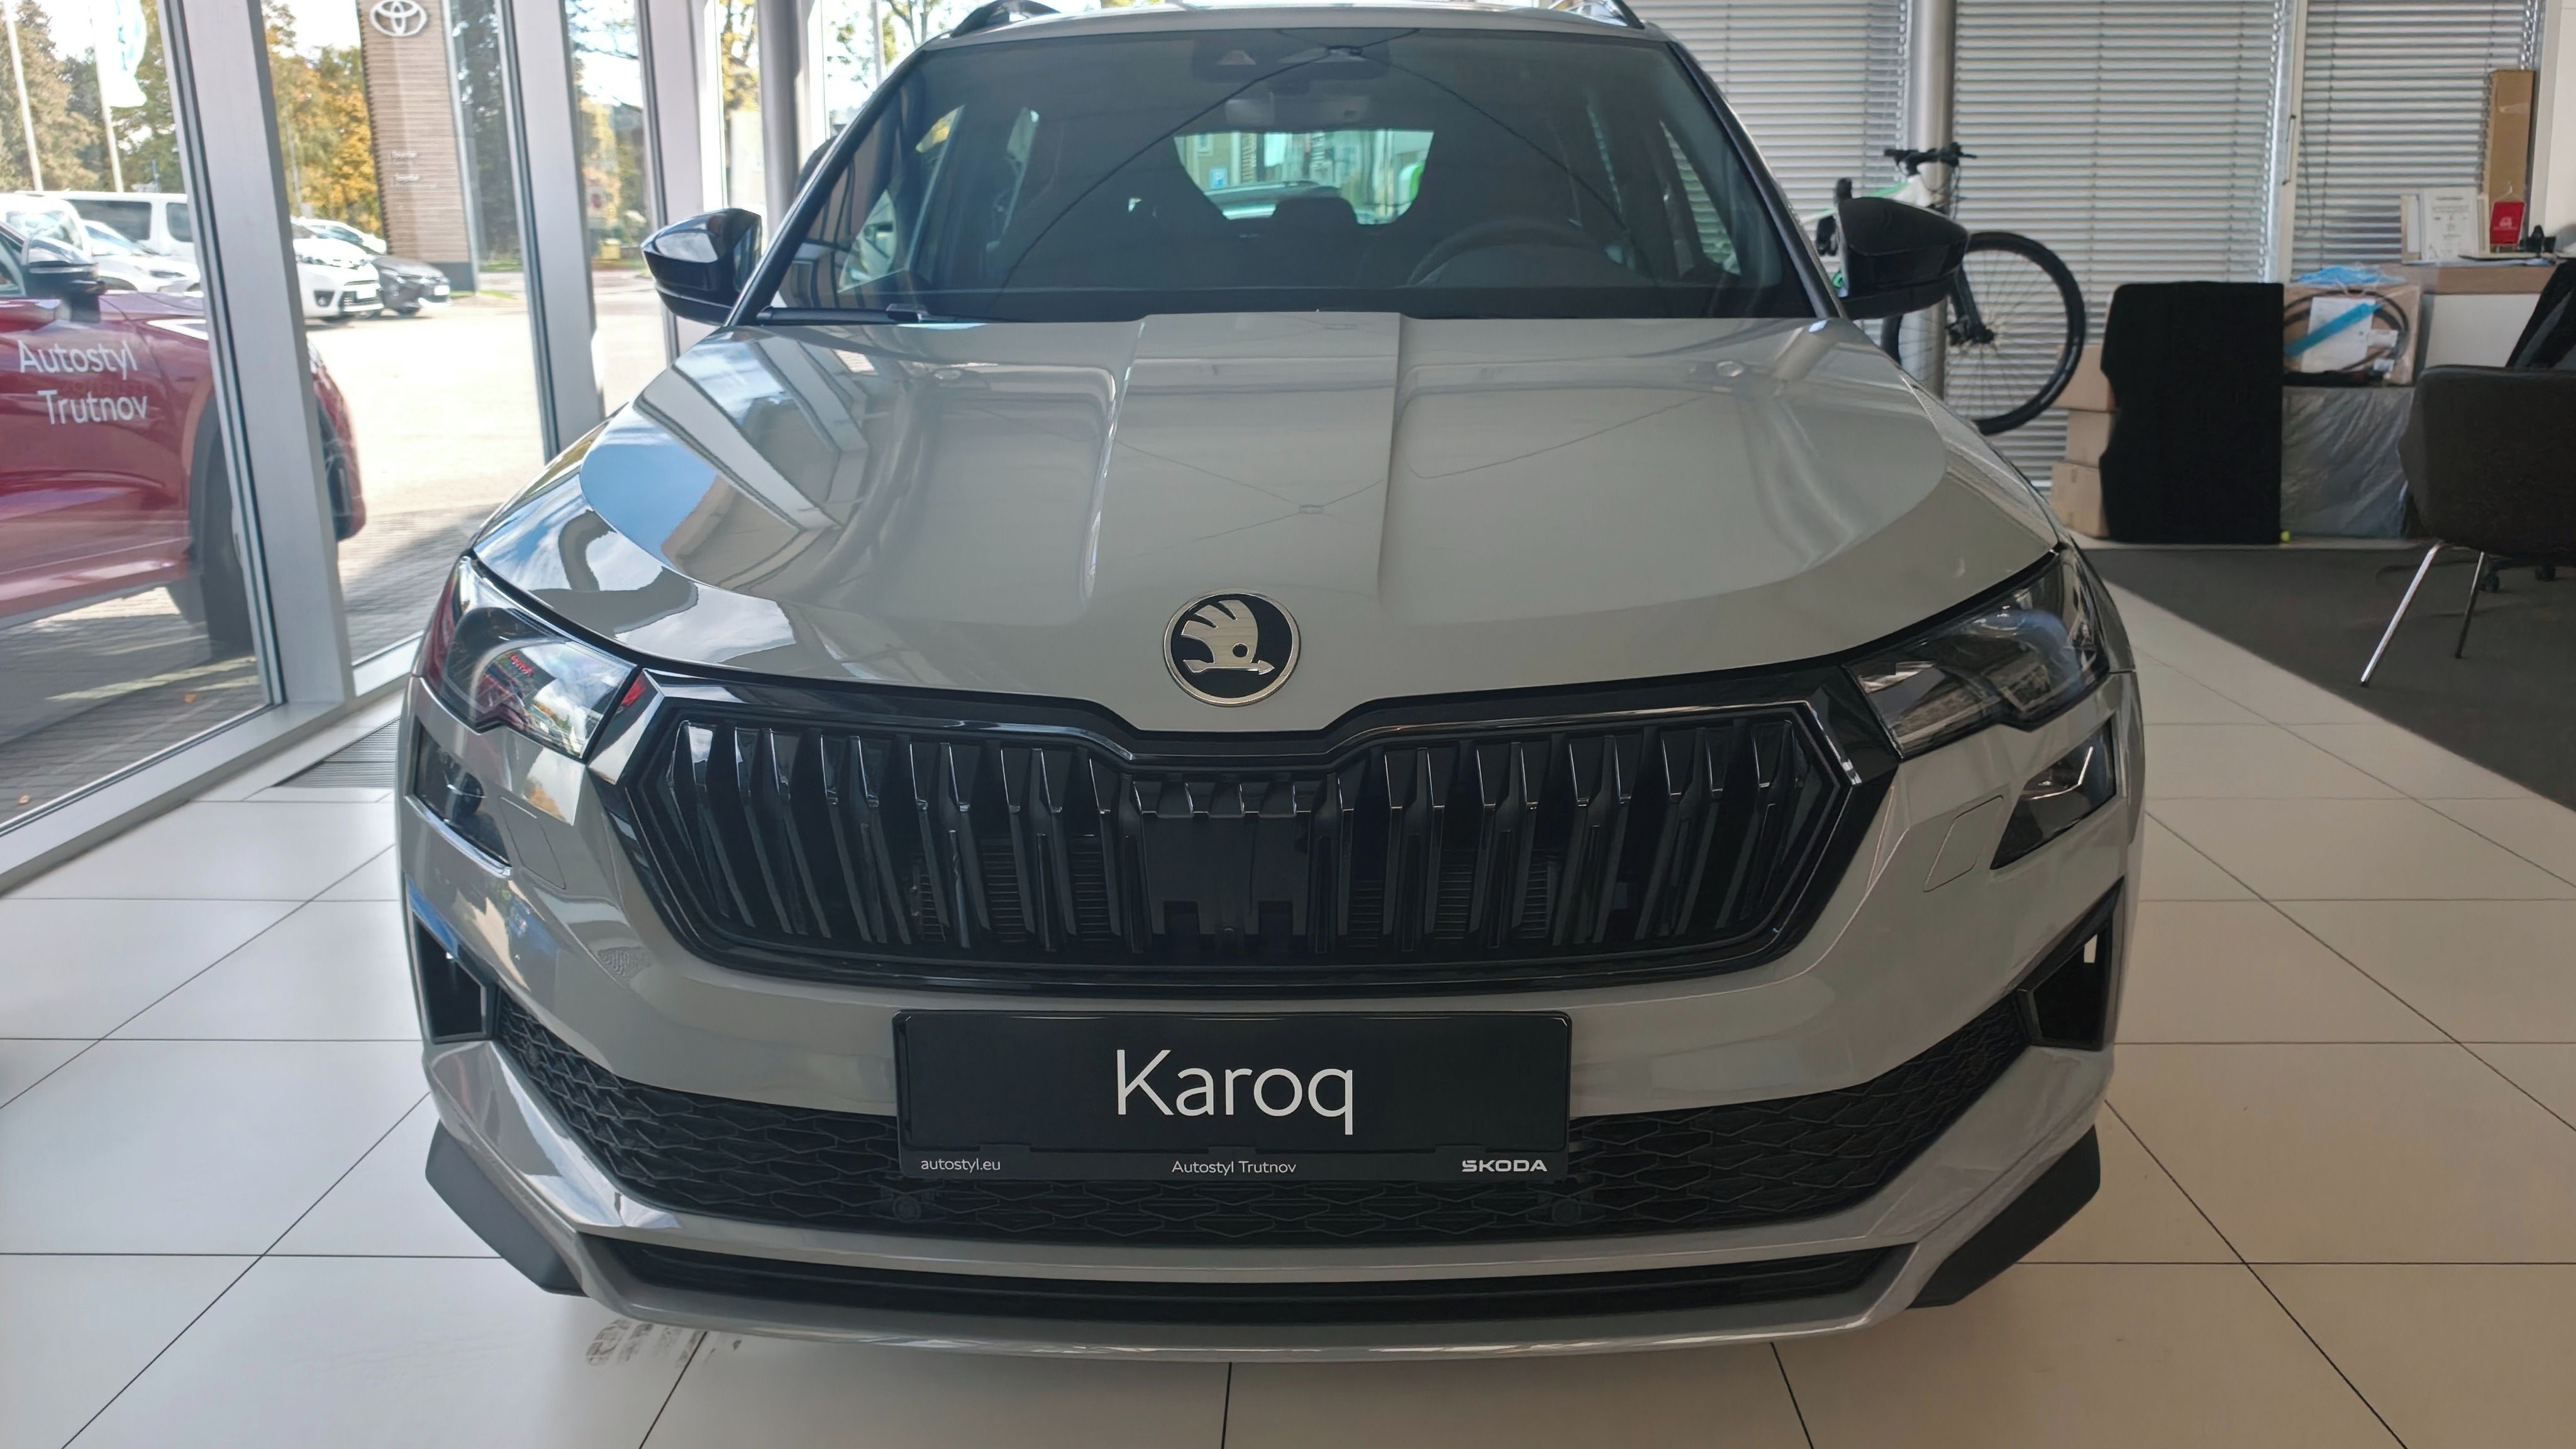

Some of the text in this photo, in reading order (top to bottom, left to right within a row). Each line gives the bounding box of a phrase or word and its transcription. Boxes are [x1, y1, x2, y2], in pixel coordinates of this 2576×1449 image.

[18, 340, 138, 380] Autostyl
[37, 389, 147, 425] Trutnov
[1116, 1049, 1353, 1135] Karoq
[921, 1158, 1001, 1173] autostyl.eu
[1172, 1160, 1296, 1176] Autostyl Trutnov
